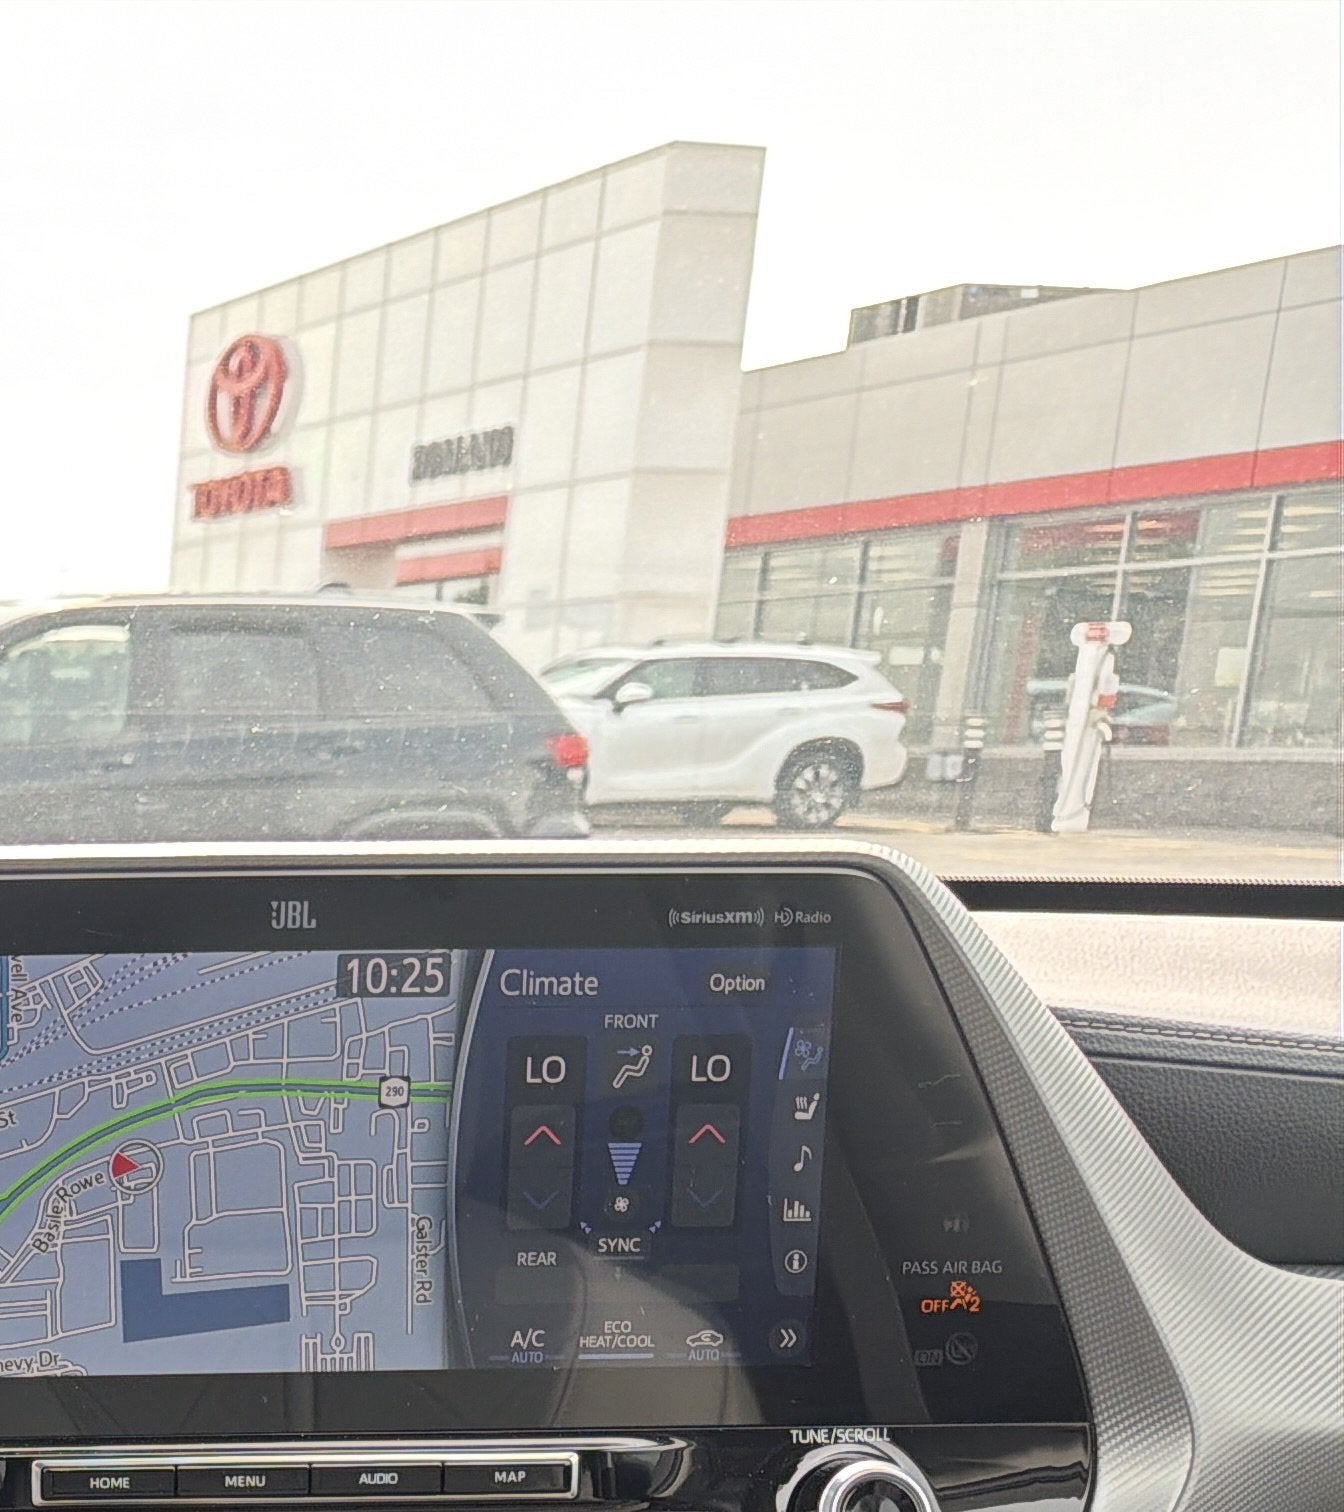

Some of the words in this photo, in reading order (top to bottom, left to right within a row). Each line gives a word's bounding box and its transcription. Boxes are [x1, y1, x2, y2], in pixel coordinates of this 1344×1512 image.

[270, 901, 317, 930] JBL
[346, 956, 445, 994] 10:25
[500, 968, 599, 997] Climate
[709, 973, 766, 993] Option
[10, 987, 27, 1023] Ave
[604, 1014, 659, 1029] FRONT
[526, 1056, 566, 1084] LO
[691, 1055, 731, 1082] LO
[385, 1086, 405, 1097] 290
[32, 1199, 64, 1253] Basile
[59, 1170, 105, 1204] Rowe
[598, 1238, 641, 1254] SYNC
[517, 1252, 557, 1267] REAR
[902, 1261, 938, 1275] PASS
[943, 1260, 967, 1274] AIR
[971, 1260, 1003, 1274] BAG
[415, 1279, 433, 1304] Rd
[921, 1299, 949, 1314] OFF
[604, 1321, 632, 1334] ECO
[511, 1328, 545, 1349] A/C
[579, 1334, 655, 1349] HEAT/COOL
[37, 1350, 60, 1368] Dr
[512, 1351, 544, 1364] AUTO
[688, 1349, 720, 1361] AUTO
[790, 1427, 891, 1445] TUNE/SCROLL
[90, 1476, 131, 1490] HOME
[224, 1474, 266, 1489] MENU
[358, 1471, 398, 1486] AUDIO
[494, 1470, 526, 1484] MAP
